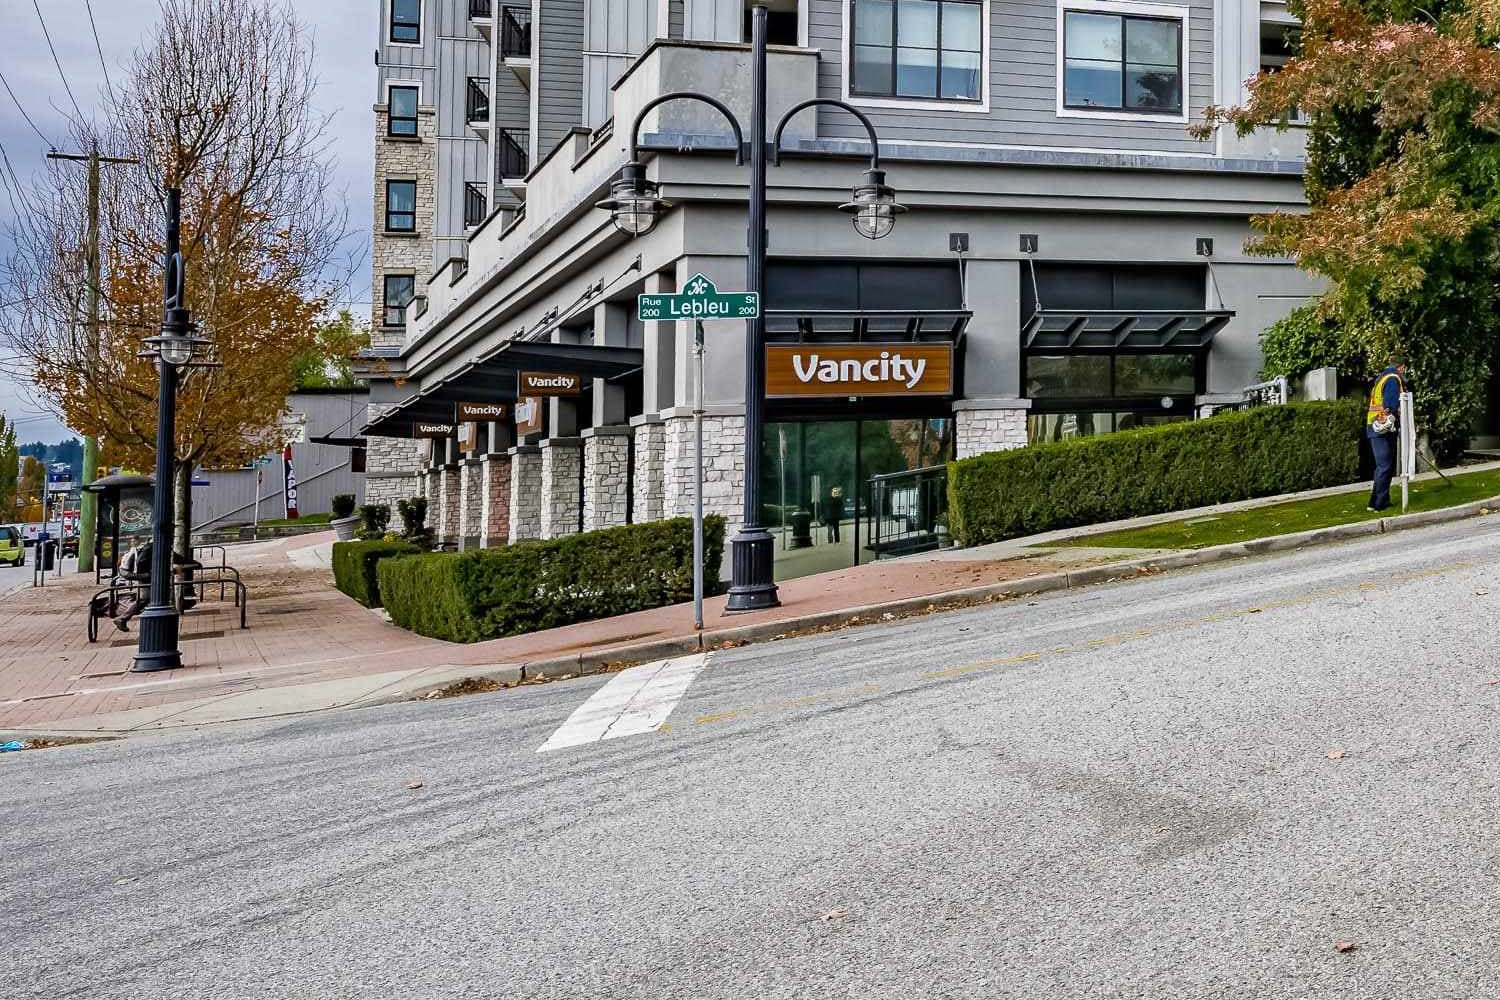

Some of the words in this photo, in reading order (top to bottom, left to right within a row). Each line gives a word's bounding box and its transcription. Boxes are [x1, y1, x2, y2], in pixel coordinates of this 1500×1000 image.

[642, 298, 662, 306] Rue
[670, 298, 729, 315] Lebleu
[745, 295, 756, 304] St
[738, 306, 756, 315] 200
[642, 308, 660, 317] 200
[792, 351, 926, 389] Vancity
[528, 376, 574, 389] Vancity
[464, 405, 502, 416] Vancity
[420, 424, 453, 434] Vancity
